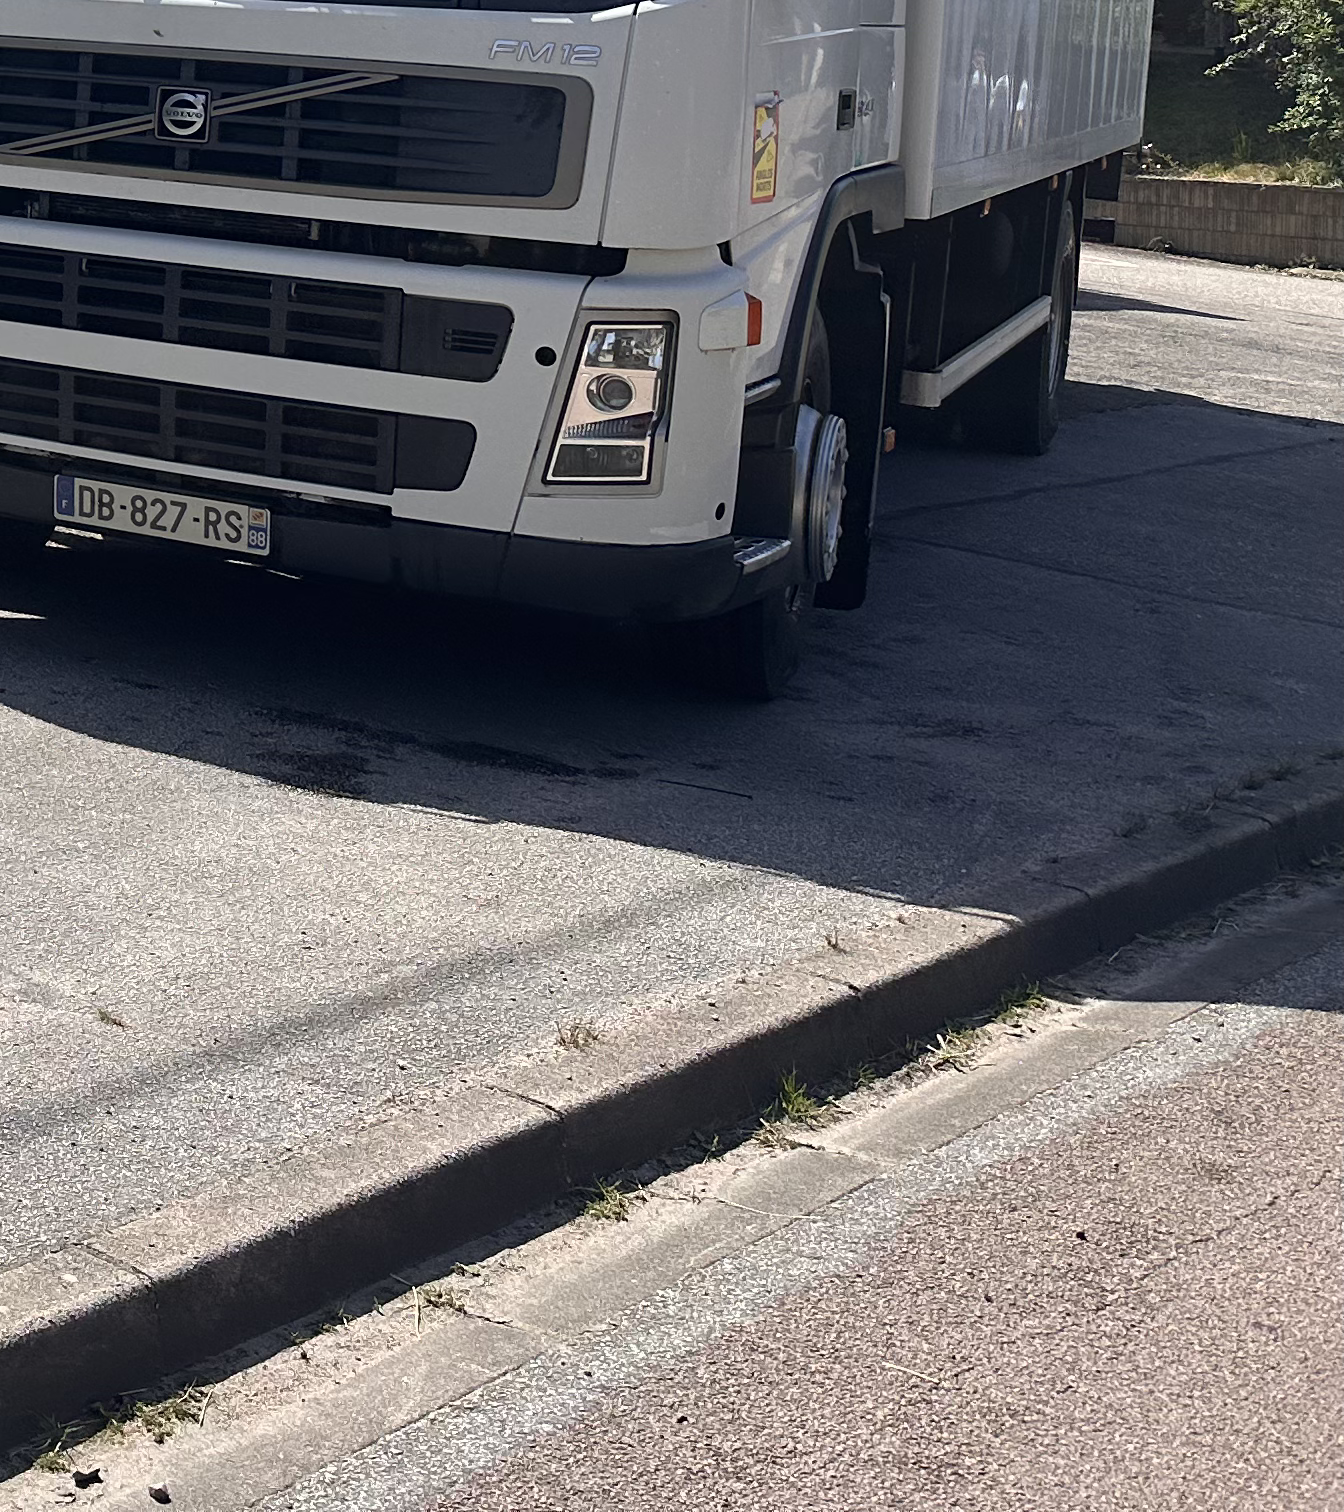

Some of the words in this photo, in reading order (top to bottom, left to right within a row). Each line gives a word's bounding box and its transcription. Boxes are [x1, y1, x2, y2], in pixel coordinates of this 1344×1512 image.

[165, 109, 203, 119] VOLVO
[61, 499, 69, 509] F
[77, 484, 243, 544] DB-827-RS
[248, 530, 266, 548] 88
